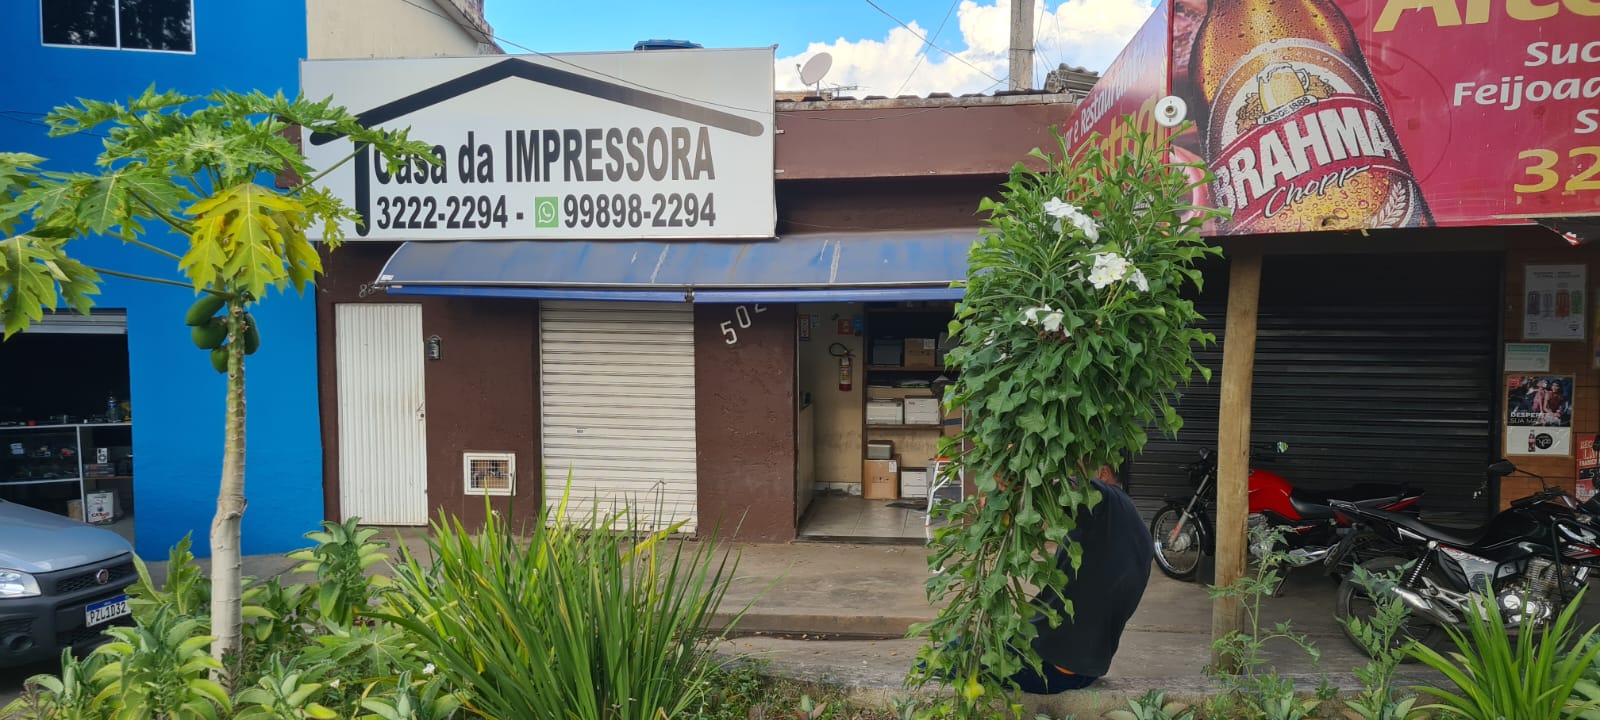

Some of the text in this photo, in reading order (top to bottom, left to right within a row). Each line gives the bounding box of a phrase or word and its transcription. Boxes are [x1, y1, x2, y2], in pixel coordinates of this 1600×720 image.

[1289, 97, 1310, 112] 1888
[458, 131, 494, 184] da
[505, 126, 715, 183] IMPRESSORA
[1213, 107, 1400, 216] BRAHMA
[1514, 146, 1600, 193] 32
[377, 195, 508, 229] 3222-2294
[564, 193, 716, 228] 99898-2294
[1264, 165, 1370, 218] Chopp
[90, 602, 127, 624] PZL1D32
